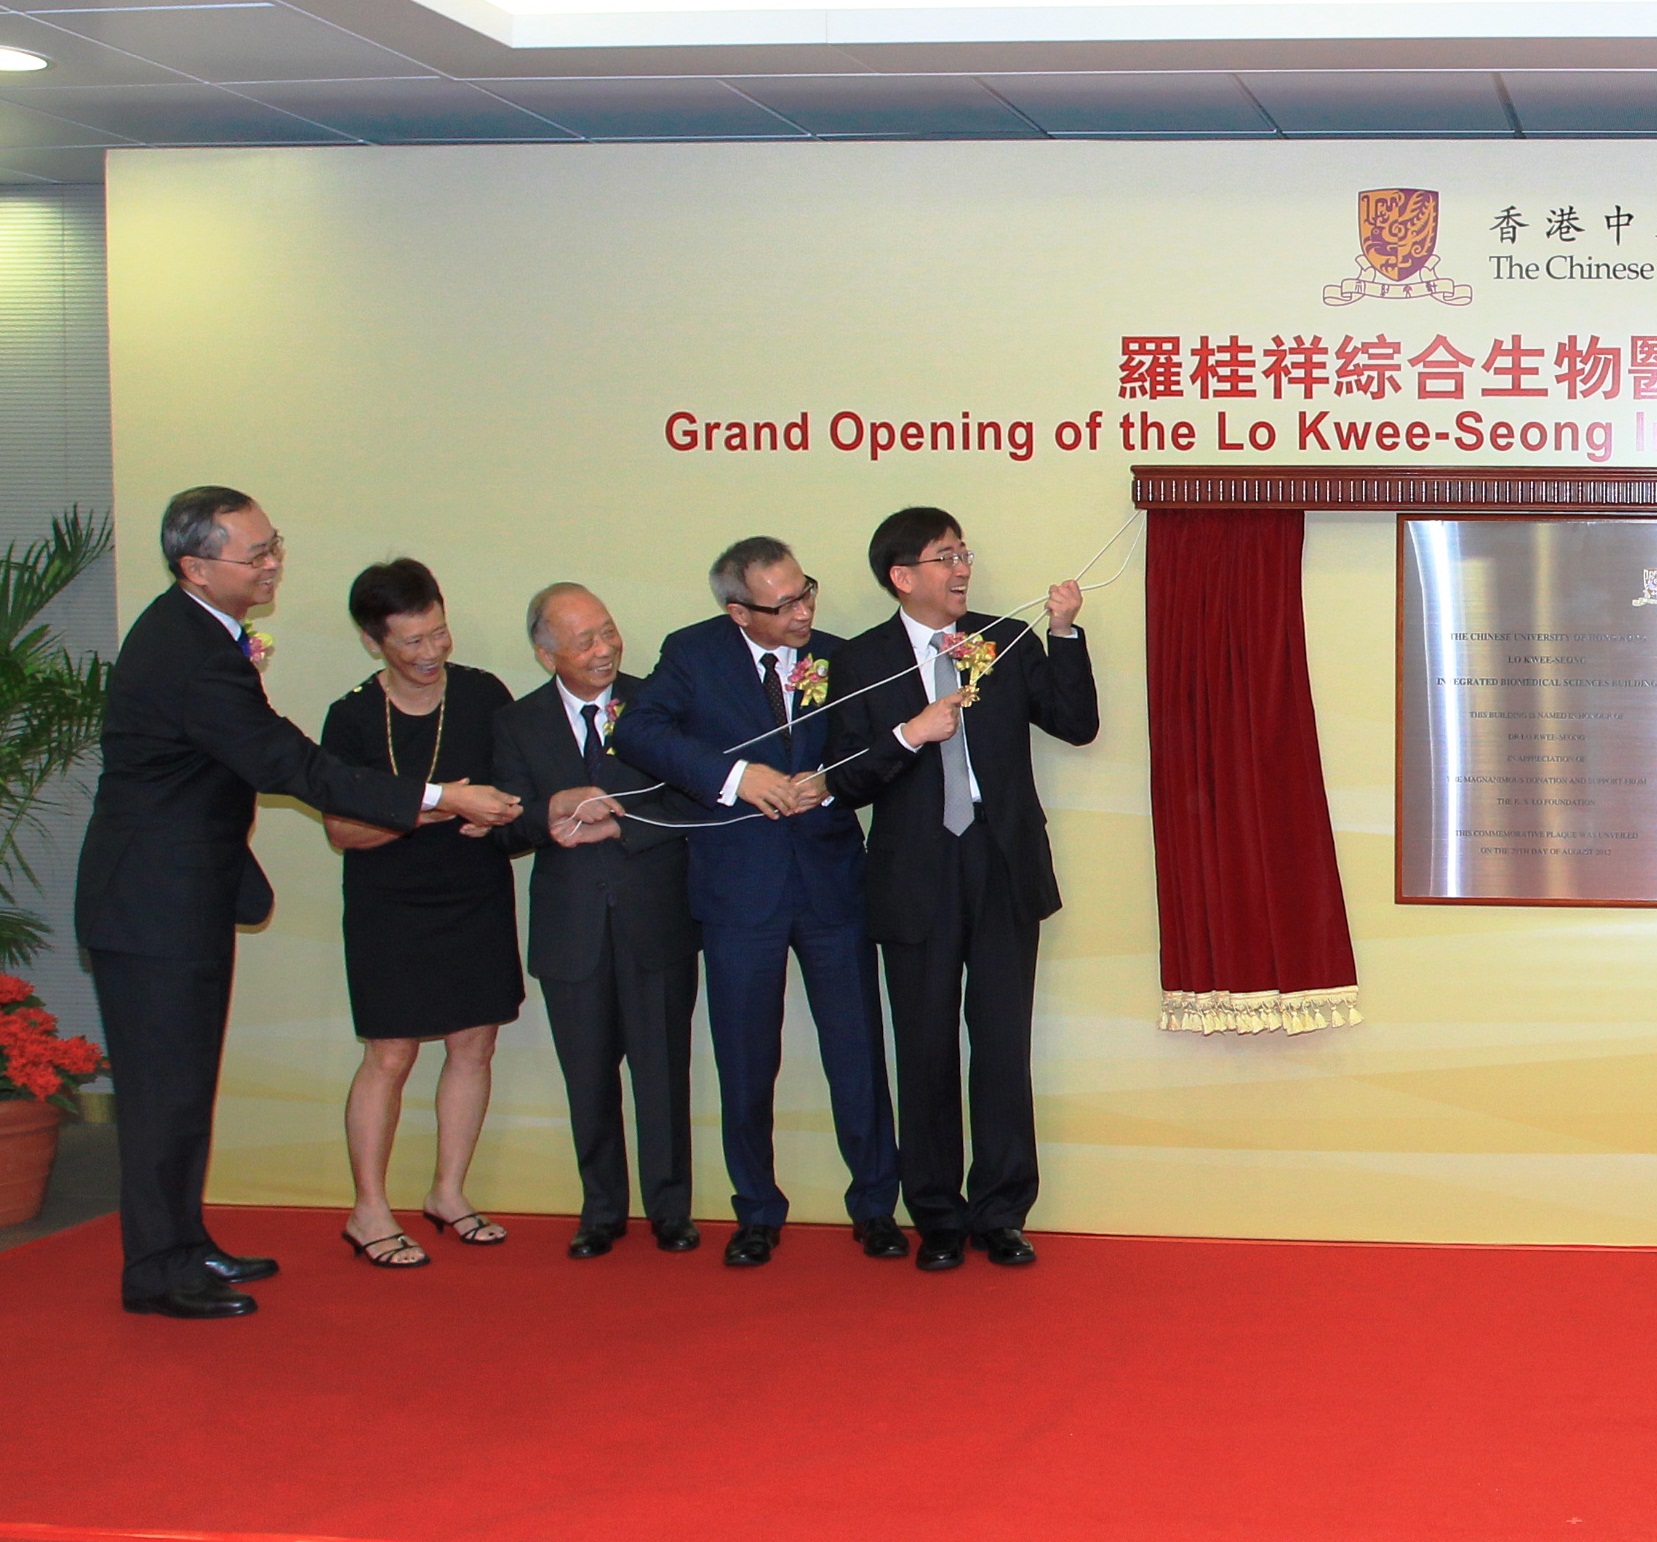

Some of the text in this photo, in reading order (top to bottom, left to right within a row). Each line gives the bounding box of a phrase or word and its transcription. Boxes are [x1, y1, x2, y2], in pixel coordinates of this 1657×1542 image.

[1488, 254, 1540, 281] The
[1545, 254, 1655, 281] Chinese
[664, 410, 811, 452] Grand
[828, 410, 1036, 462] Opening
[1054, 410, 1104, 452] of
[1120, 411, 1197, 453] the
[1217, 411, 1277, 453] Lo
[1299, 411, 1614, 464] Kwee-Seong
[1450, 632, 1468, 641] THE
[1470, 632, 1511, 641] CHINESE
[1513, 632, 1570, 642] UNIVERSITY
[1507, 655, 1521, 664] LO
[1436, 677, 1499, 686] INEGRATED
[1500, 678, 1561, 687] BIOMEDICAL
[1563, 679, 1610, 688] SCIENCES
[1469, 711, 1487, 719] THIS
[1488, 711, 1527, 720] BUILDING
[1538, 712, 1567, 720] NAMED
[1519, 755, 1574, 763] APPRECIATION
[1446, 776, 1462, 784] TE
[1525, 776, 1568, 785] DONATION
[1496, 797, 1512, 806] THE
[1544, 798, 1596, 807] FOUNDATION
[1546, 831, 1577, 839] PLAQUE
[1531, 848, 1547, 856] DAY
